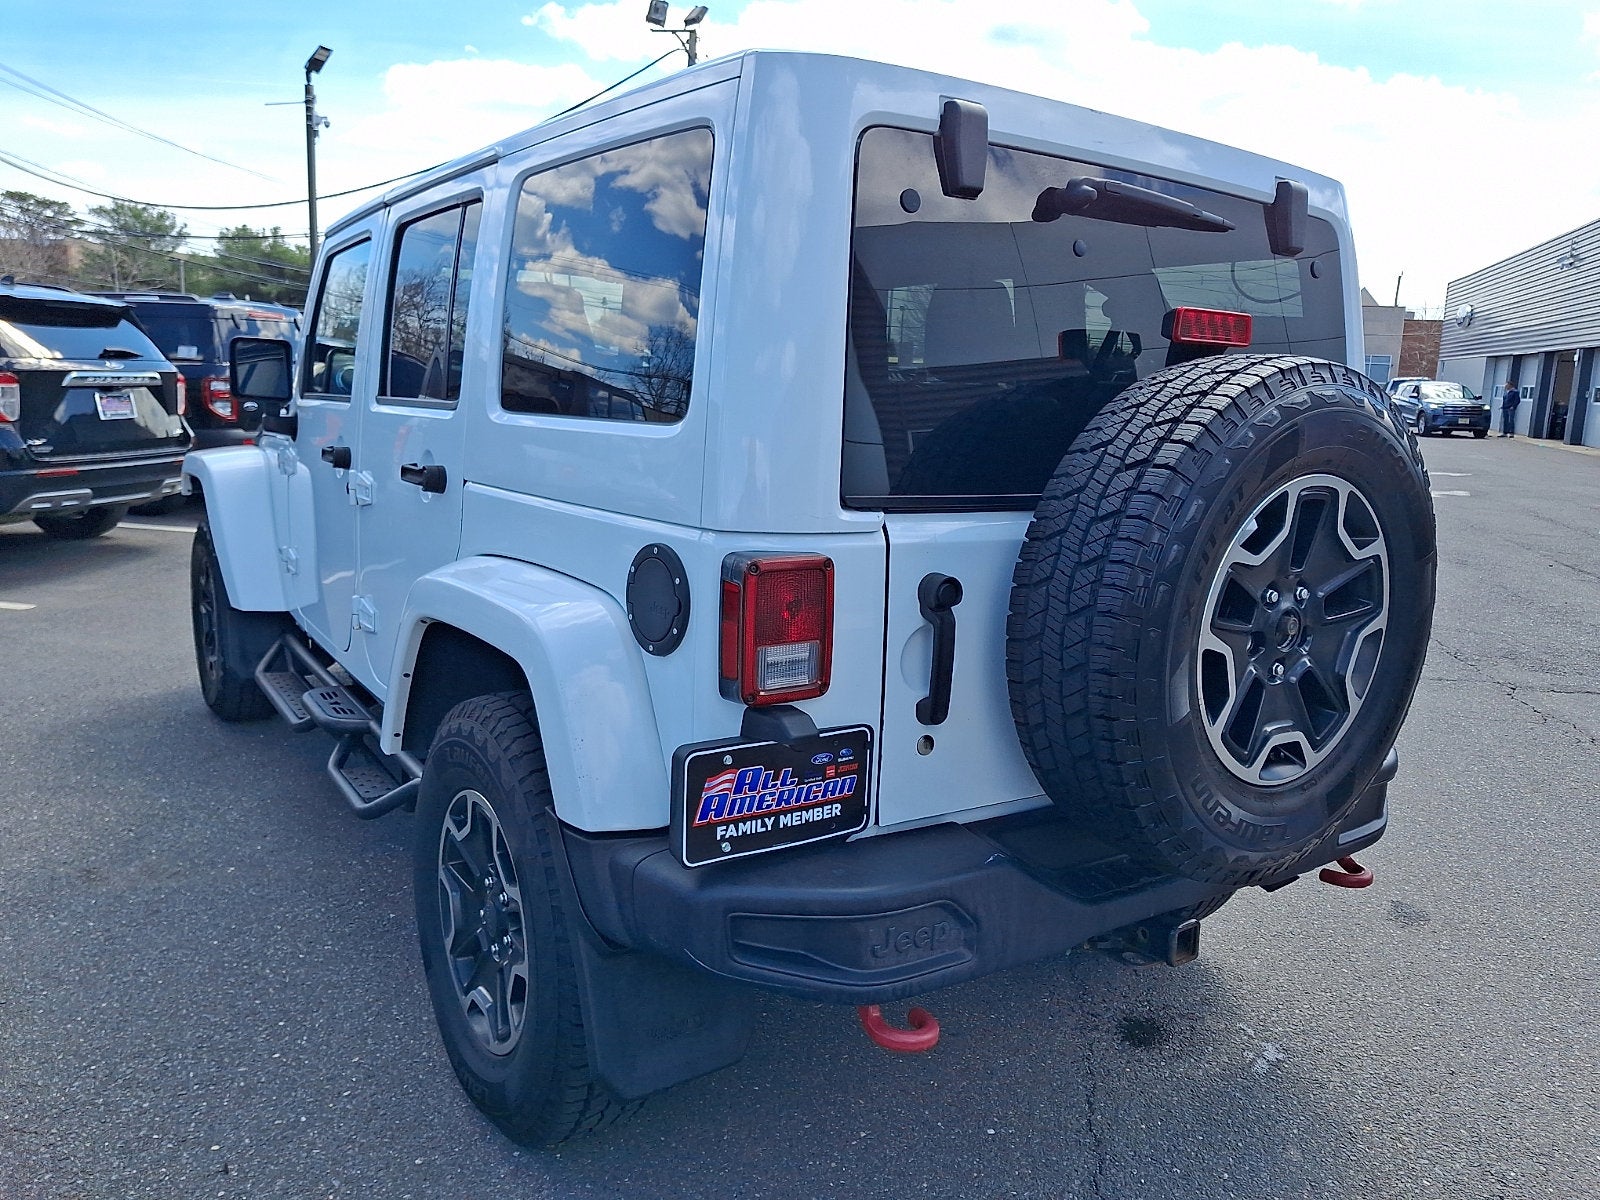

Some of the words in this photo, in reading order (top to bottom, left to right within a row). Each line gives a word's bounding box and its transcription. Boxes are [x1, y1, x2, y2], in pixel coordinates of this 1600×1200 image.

[813, 754, 831, 764] Ford
[732, 765, 798, 796] ALL
[694, 775, 858, 827] AMERICAN
[716, 817, 776, 841] FAMILY
[779, 803, 842, 829] MEMBER
[871, 921, 951, 959] Jeep
